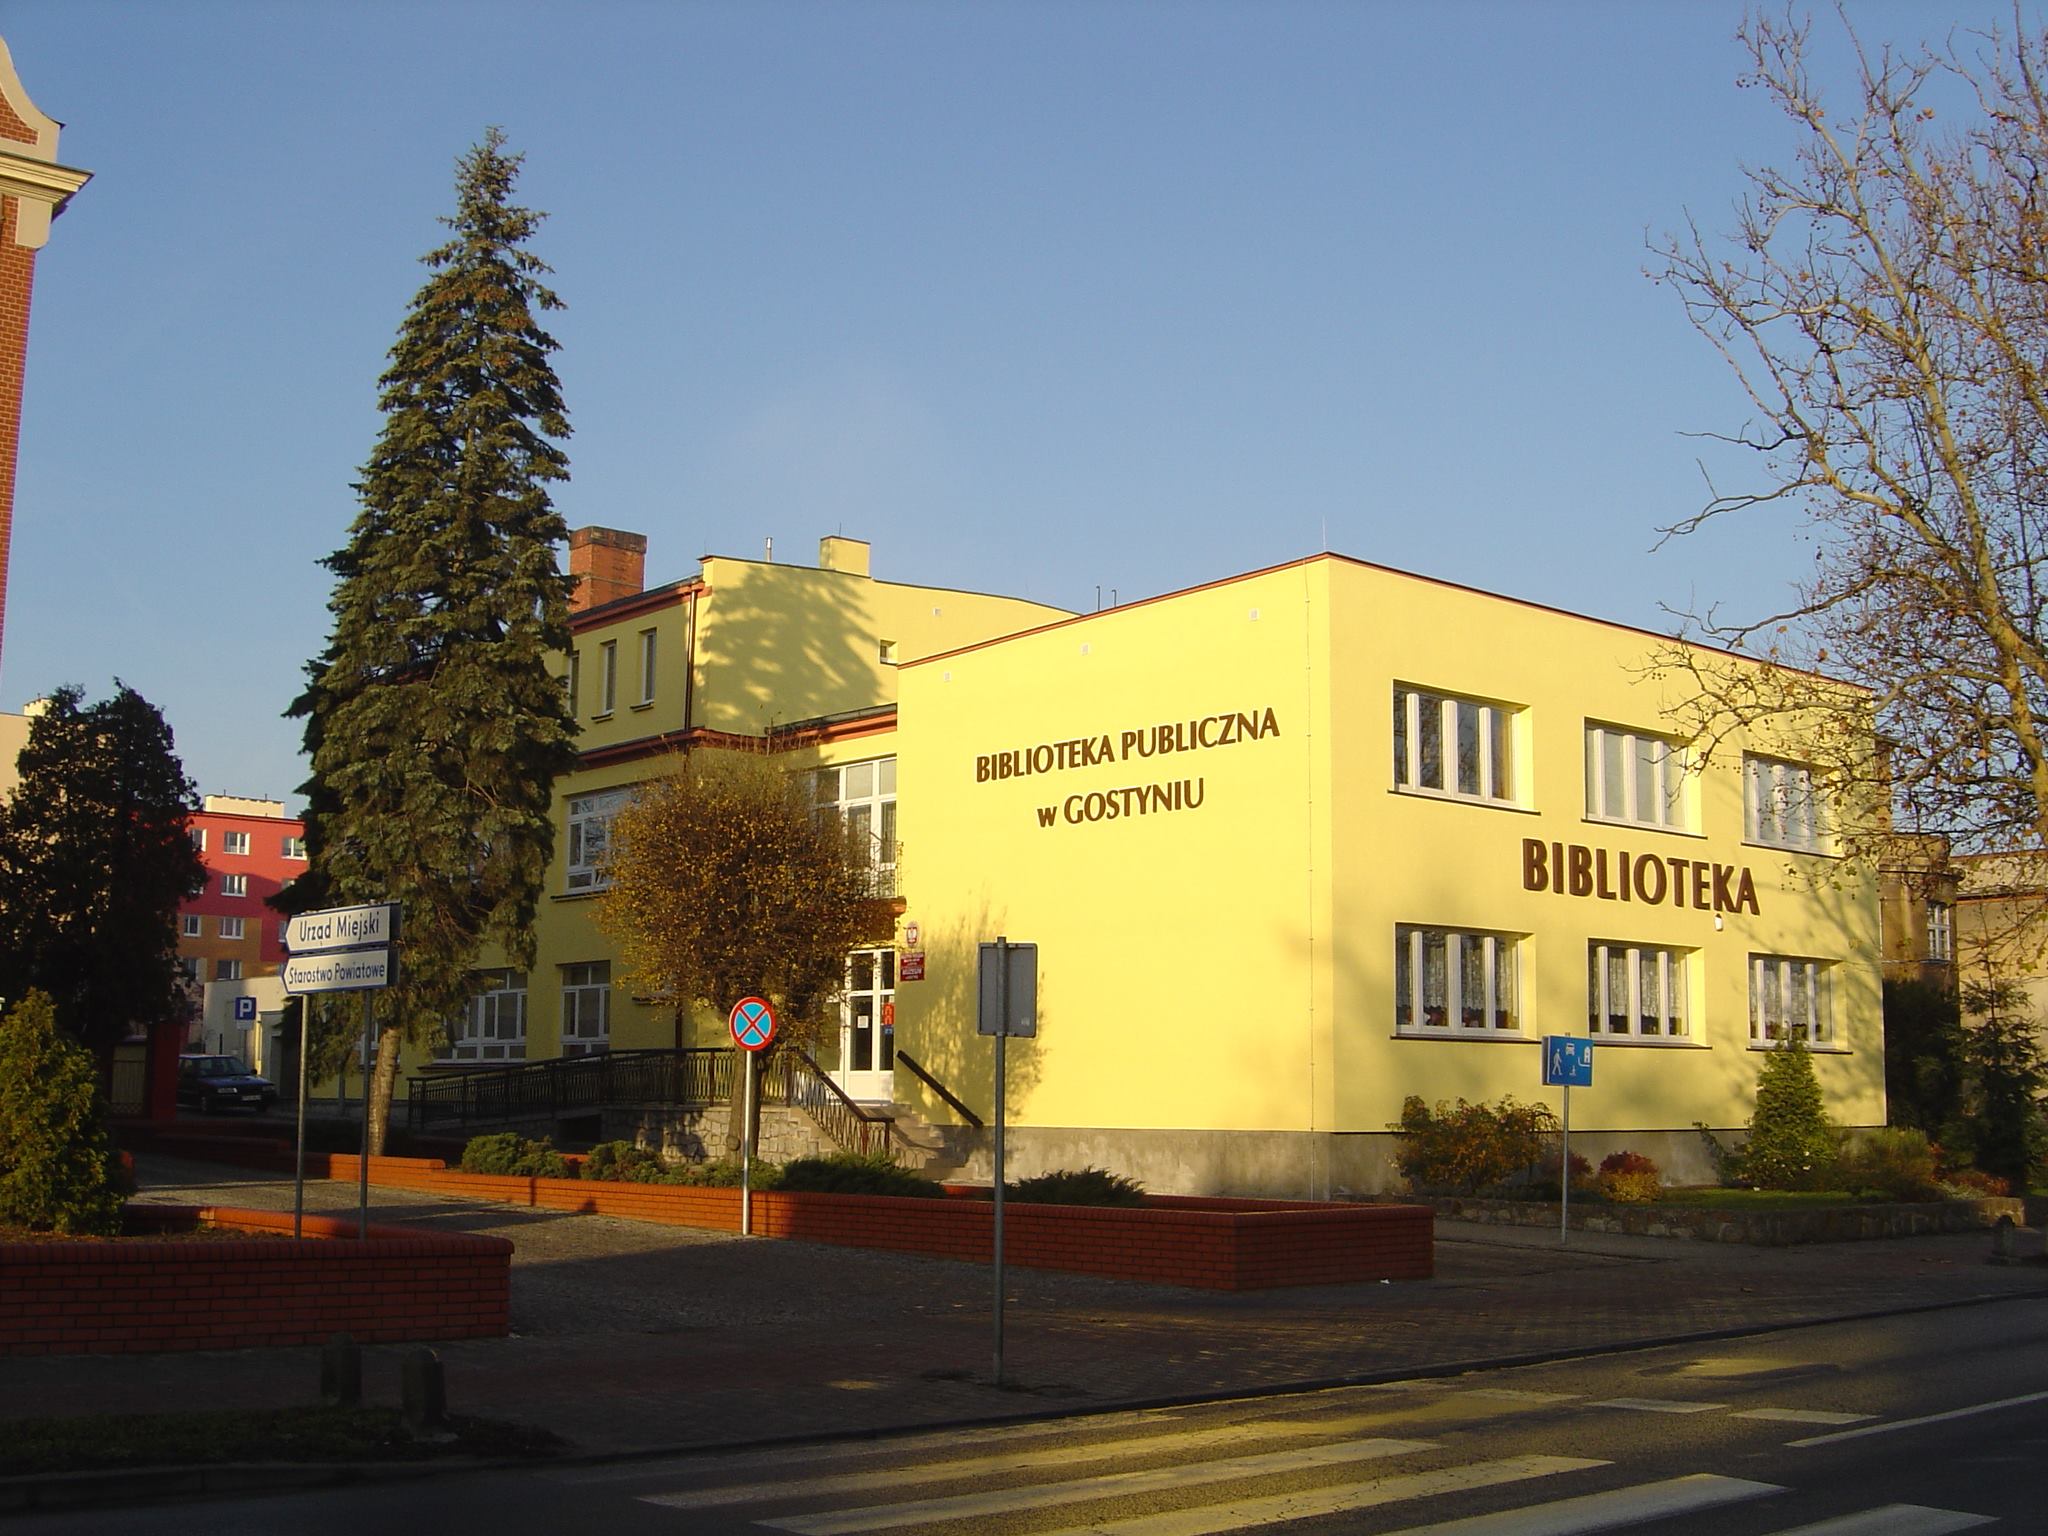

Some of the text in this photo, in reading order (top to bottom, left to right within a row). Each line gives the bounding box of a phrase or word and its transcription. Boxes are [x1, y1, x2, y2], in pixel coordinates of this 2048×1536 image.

[976, 707, 1280, 783] BIBLIOTEKA PUBLICZNA
[1037, 777, 1204, 828] w GOSTYNIU
[1522, 838, 1761, 916] BIBLIOTEKA
[336, 911, 380, 941] Miejski
[288, 962, 385, 985] Starostwo Powiatowe
[239, 999, 253, 1018] P
